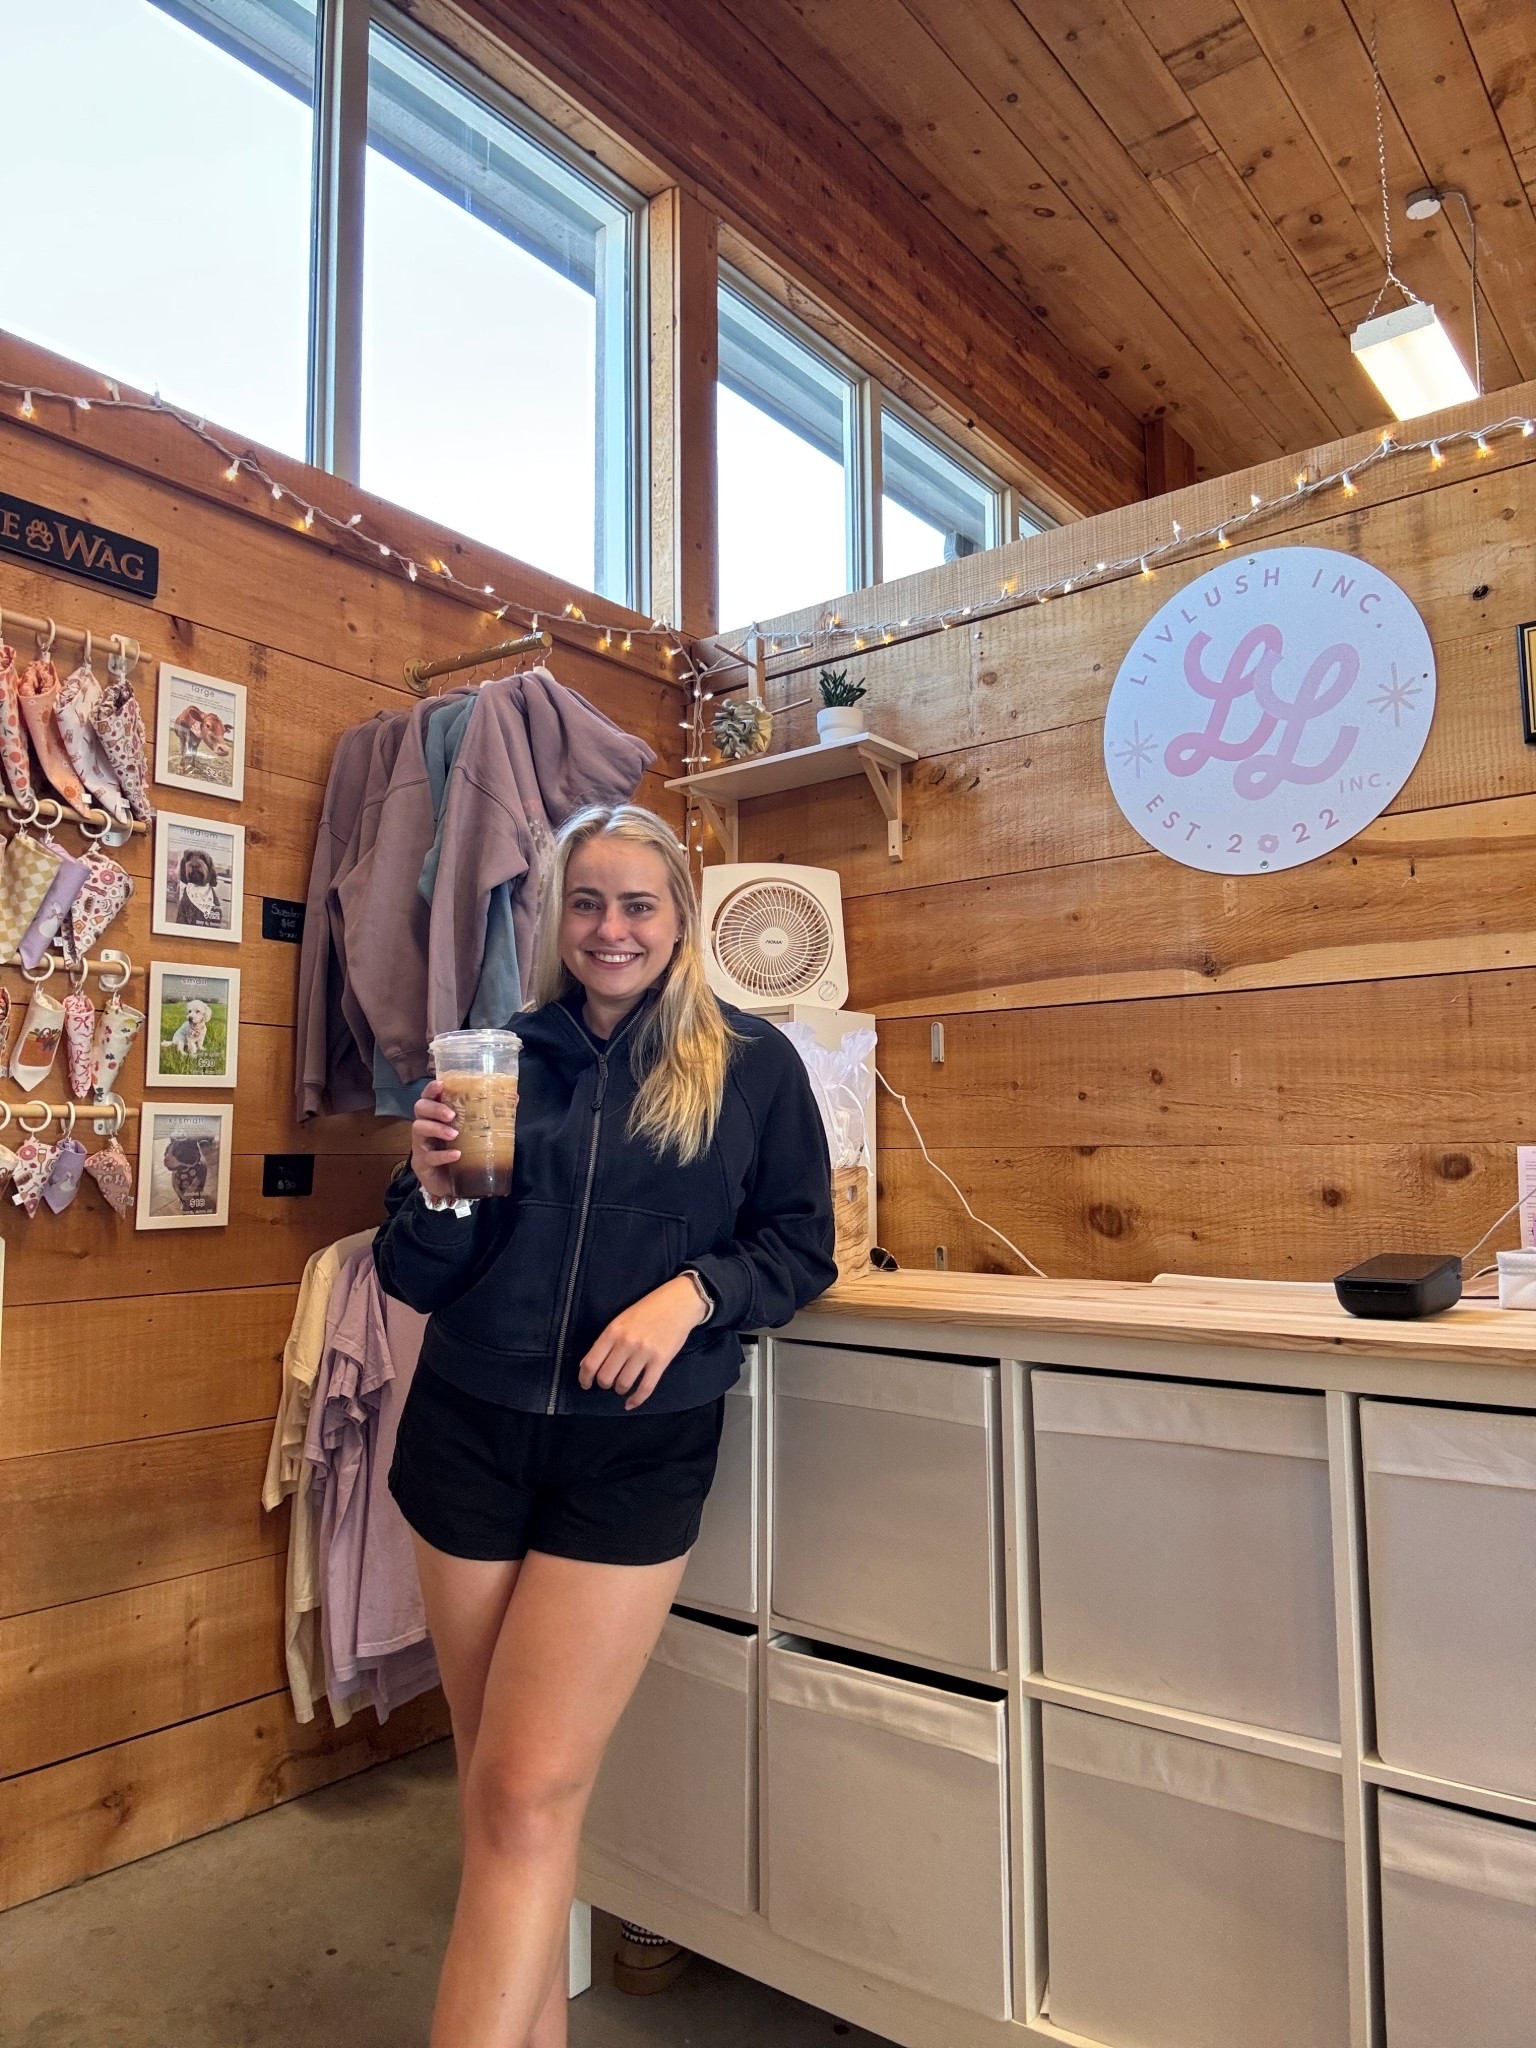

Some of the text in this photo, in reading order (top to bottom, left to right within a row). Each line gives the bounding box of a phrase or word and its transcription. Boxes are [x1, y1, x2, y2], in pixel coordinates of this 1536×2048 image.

[1130, 567, 1382, 686] LIVLUSH INC.
[1339, 773, 1391, 794] INC.
[182, 977, 208, 986] small
[198, 1058, 216, 1068] $20
